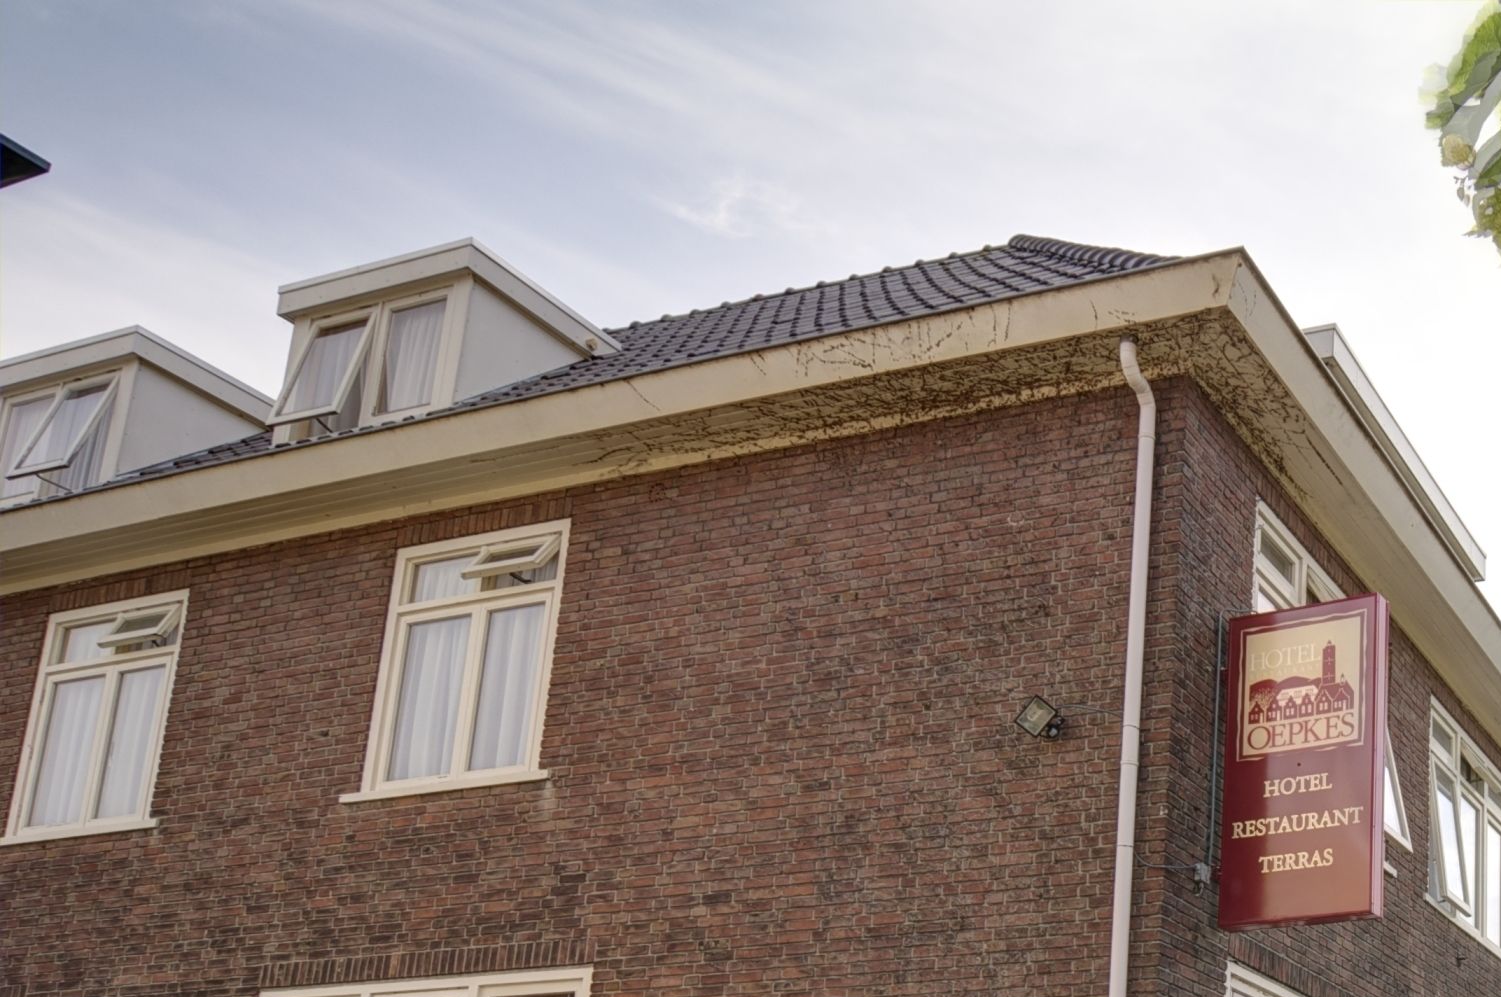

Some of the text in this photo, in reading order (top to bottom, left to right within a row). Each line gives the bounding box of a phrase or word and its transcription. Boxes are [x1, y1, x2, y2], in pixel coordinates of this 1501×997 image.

[1250, 643, 1321, 671] HOTEL
[1247, 711, 1355, 751] OEPKES
[1263, 772, 1333, 798] HOTEL
[1231, 806, 1364, 839] RESTAURANT
[1258, 848, 1334, 874] TERRAS
